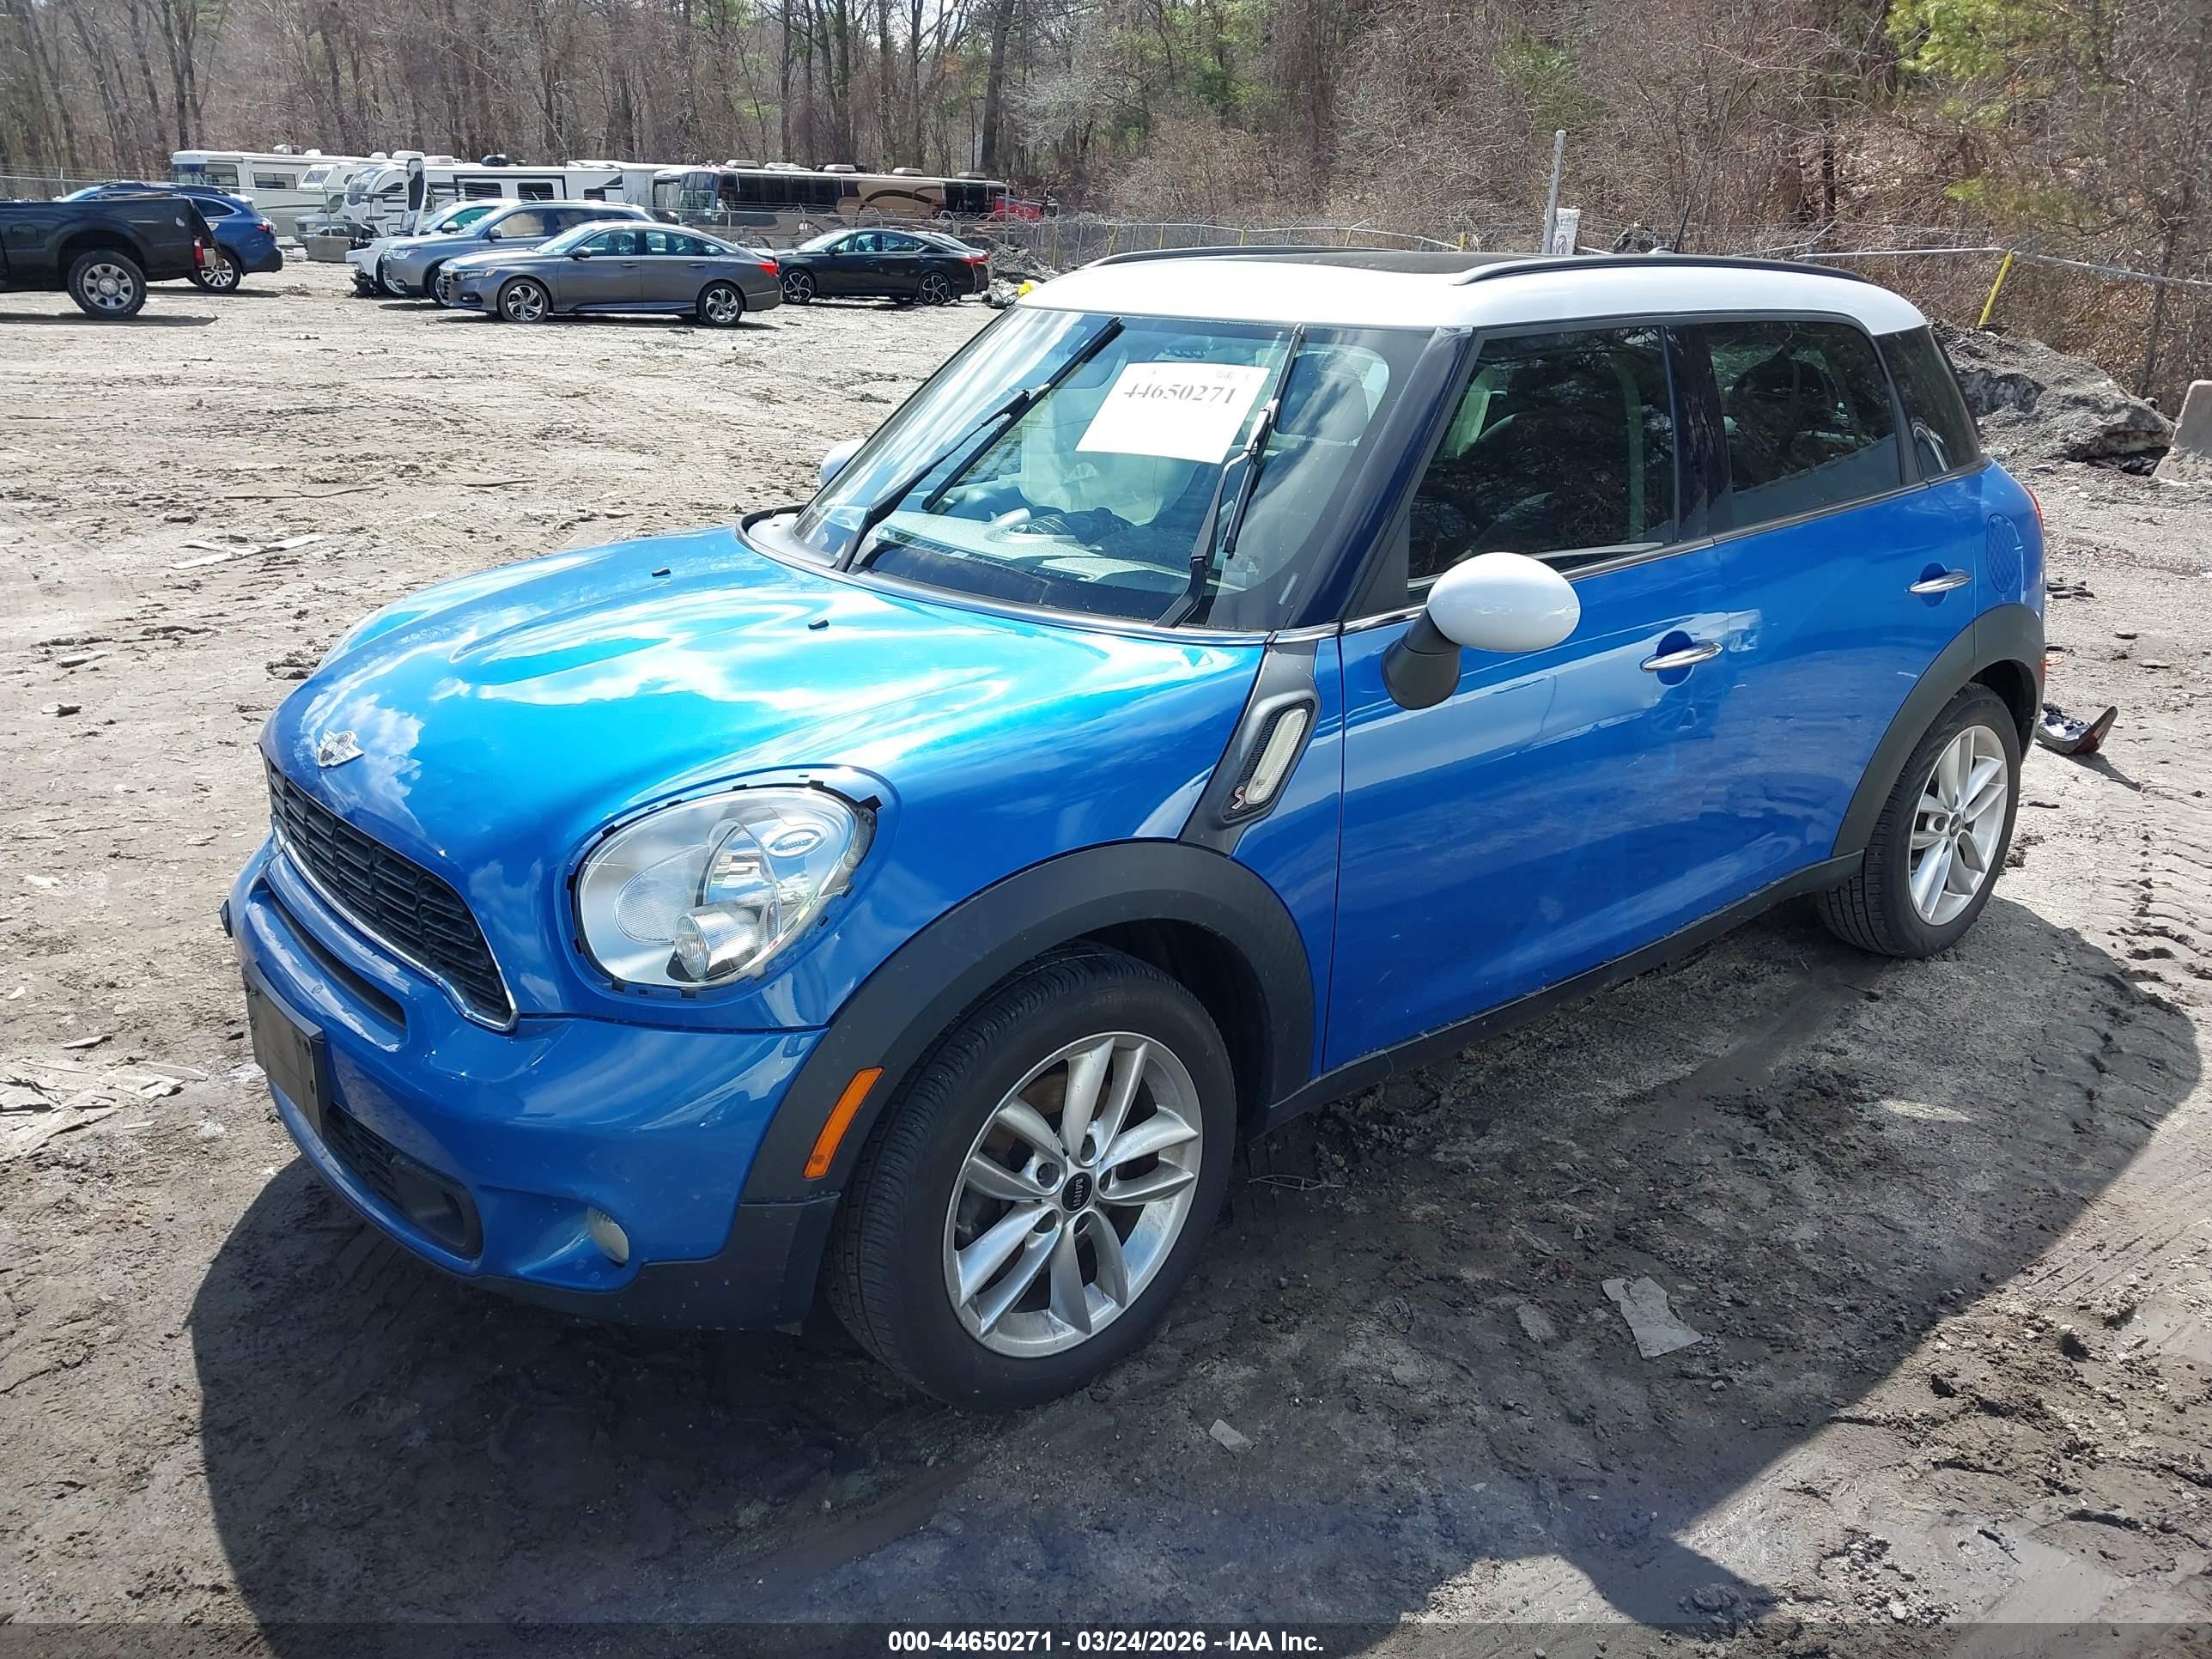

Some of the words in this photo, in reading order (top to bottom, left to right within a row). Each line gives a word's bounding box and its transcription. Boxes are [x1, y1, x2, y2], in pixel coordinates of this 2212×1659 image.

[1123, 382, 1237, 404] 44650271
[1231, 786, 1245, 810] S
[1072, 1177, 1084, 1207] MINI
